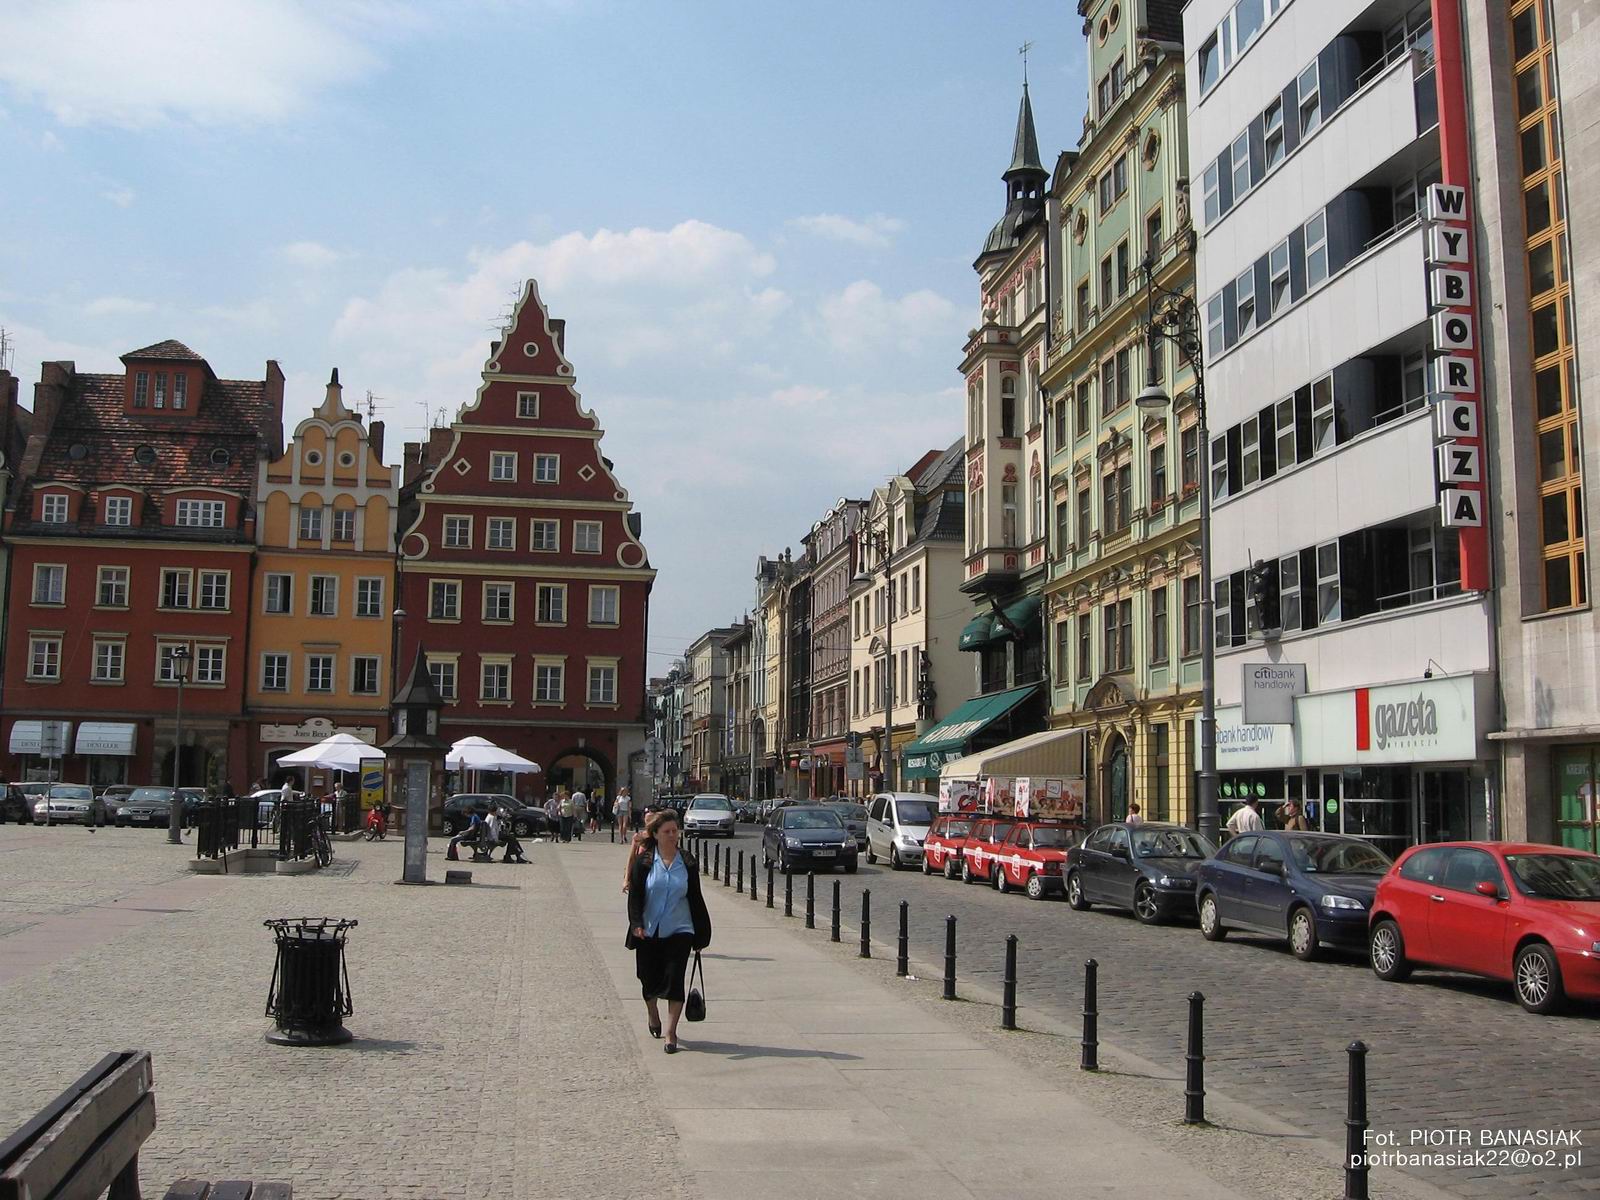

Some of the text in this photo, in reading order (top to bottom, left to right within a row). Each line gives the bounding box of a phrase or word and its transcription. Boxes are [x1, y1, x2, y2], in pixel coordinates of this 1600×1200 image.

[1436, 189, 1477, 521] WYBORCZA
[1254, 666, 1296, 679] citibank
[1254, 680, 1296, 691] handlowy
[1375, 691, 1438, 750] gazeta
[1236, 724, 1274, 744] handlowy
[1387, 739, 1438, 748] WYBORCZA
